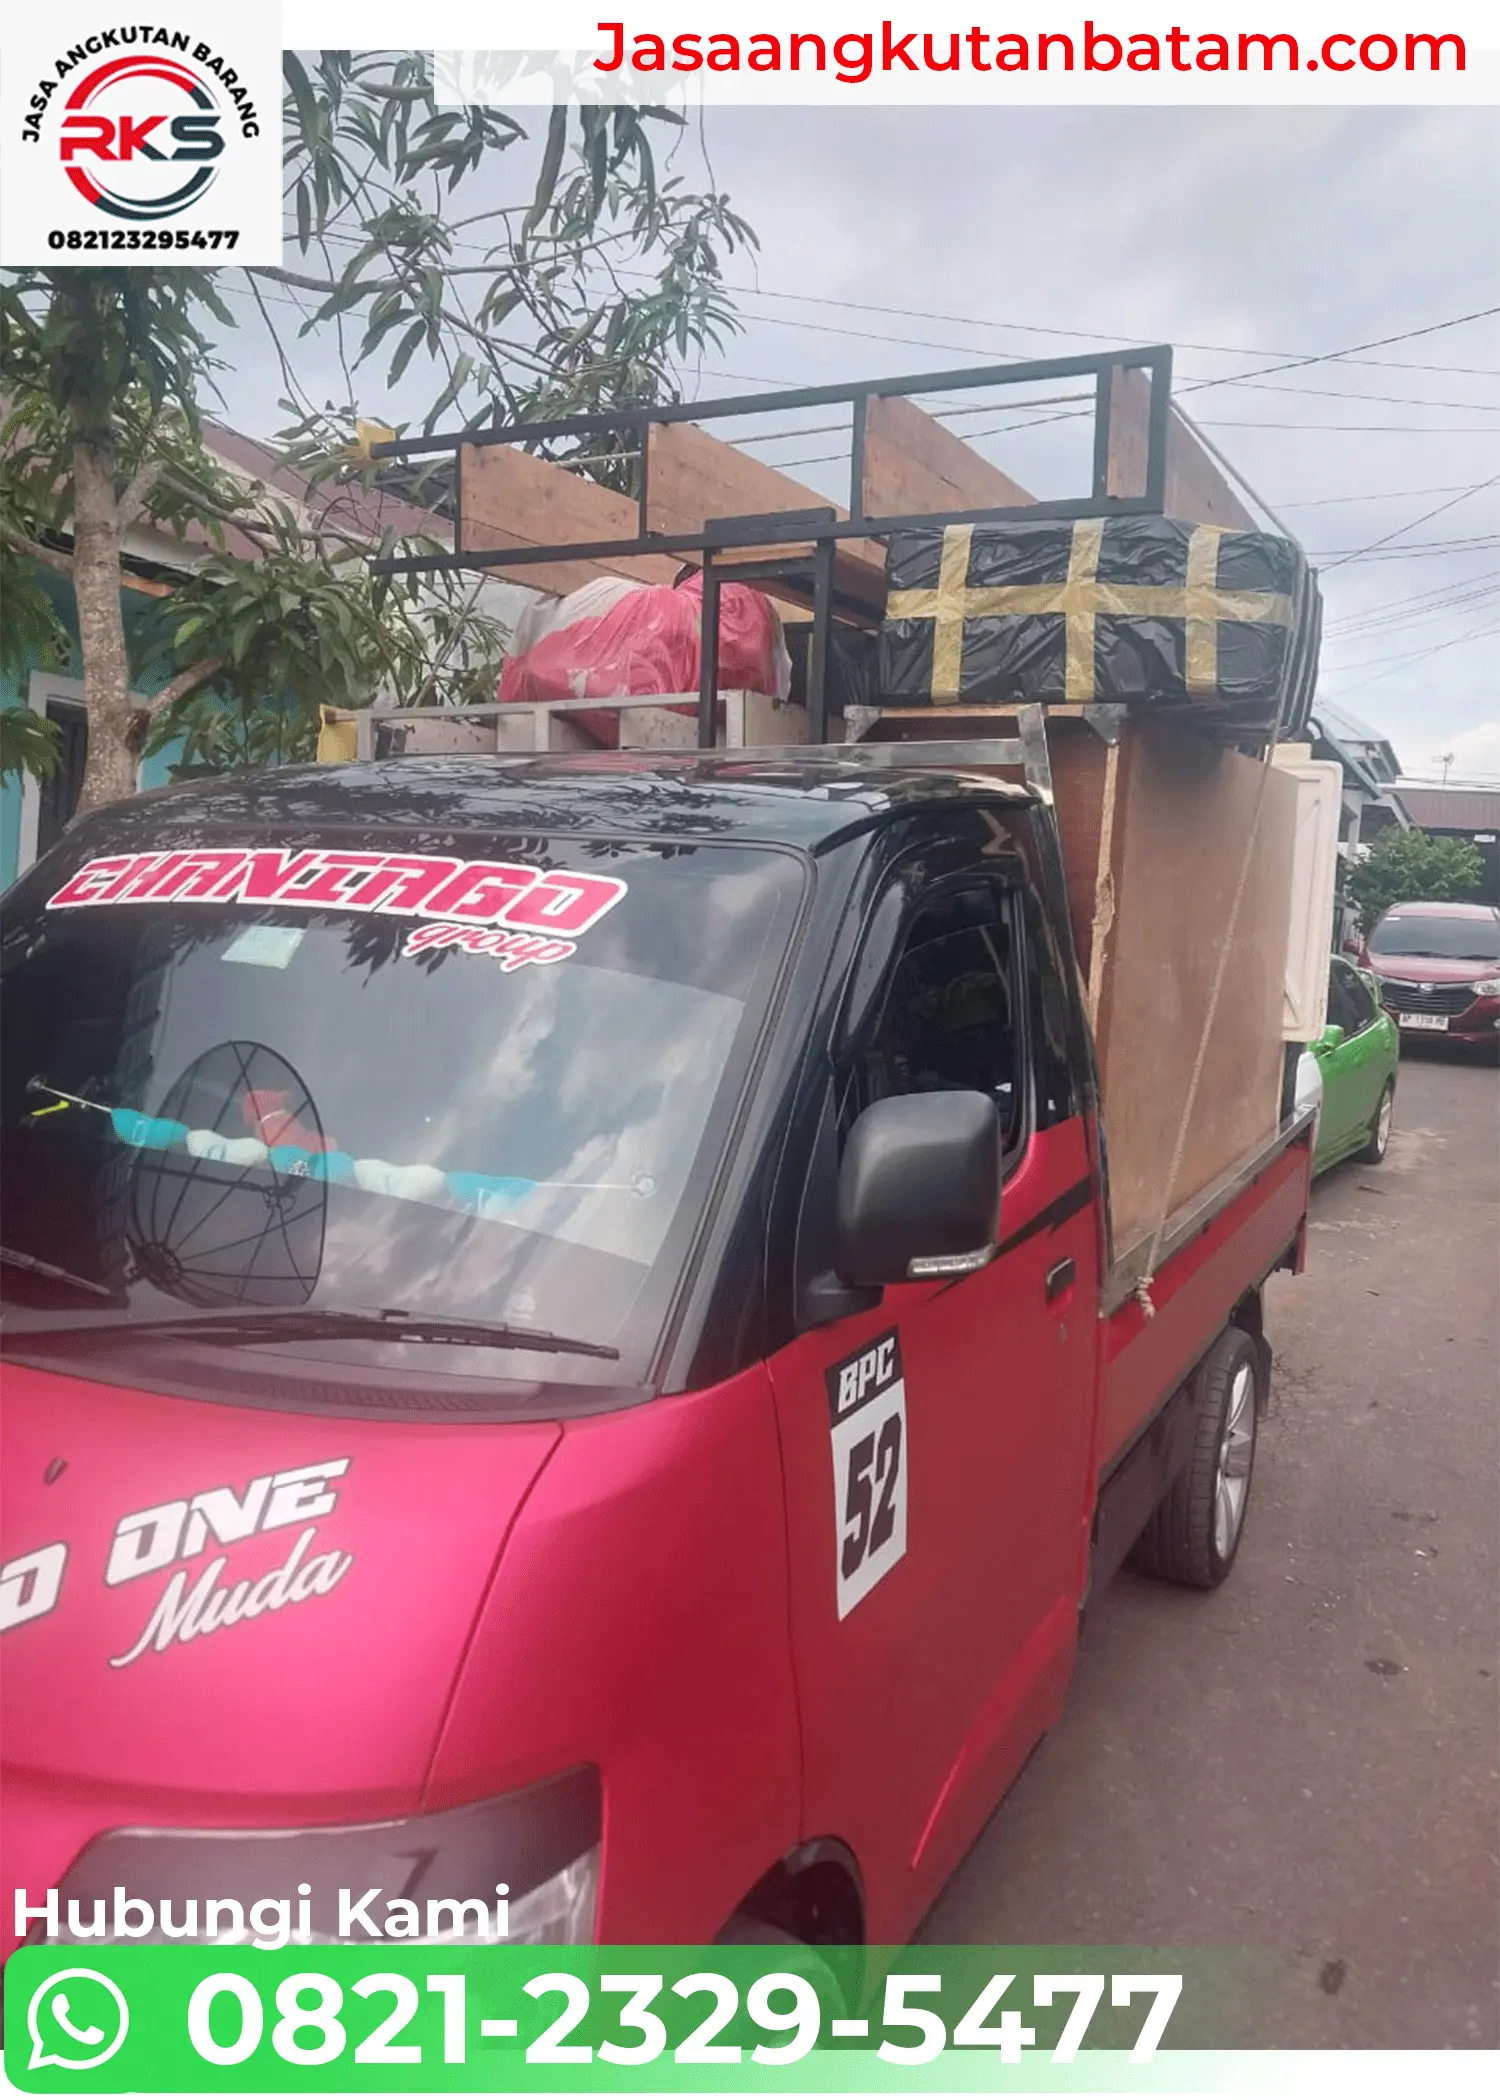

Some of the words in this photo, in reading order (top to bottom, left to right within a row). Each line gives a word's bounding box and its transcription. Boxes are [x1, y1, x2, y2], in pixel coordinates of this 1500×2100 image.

[46, 848, 627, 937] CHANIAGO
[402, 922, 577, 972] group
[838, 1336, 895, 1413] BPC
[106, 1456, 352, 1586] ONE
[841, 1412, 902, 1581] 52
[108, 1526, 354, 1669] Muda
